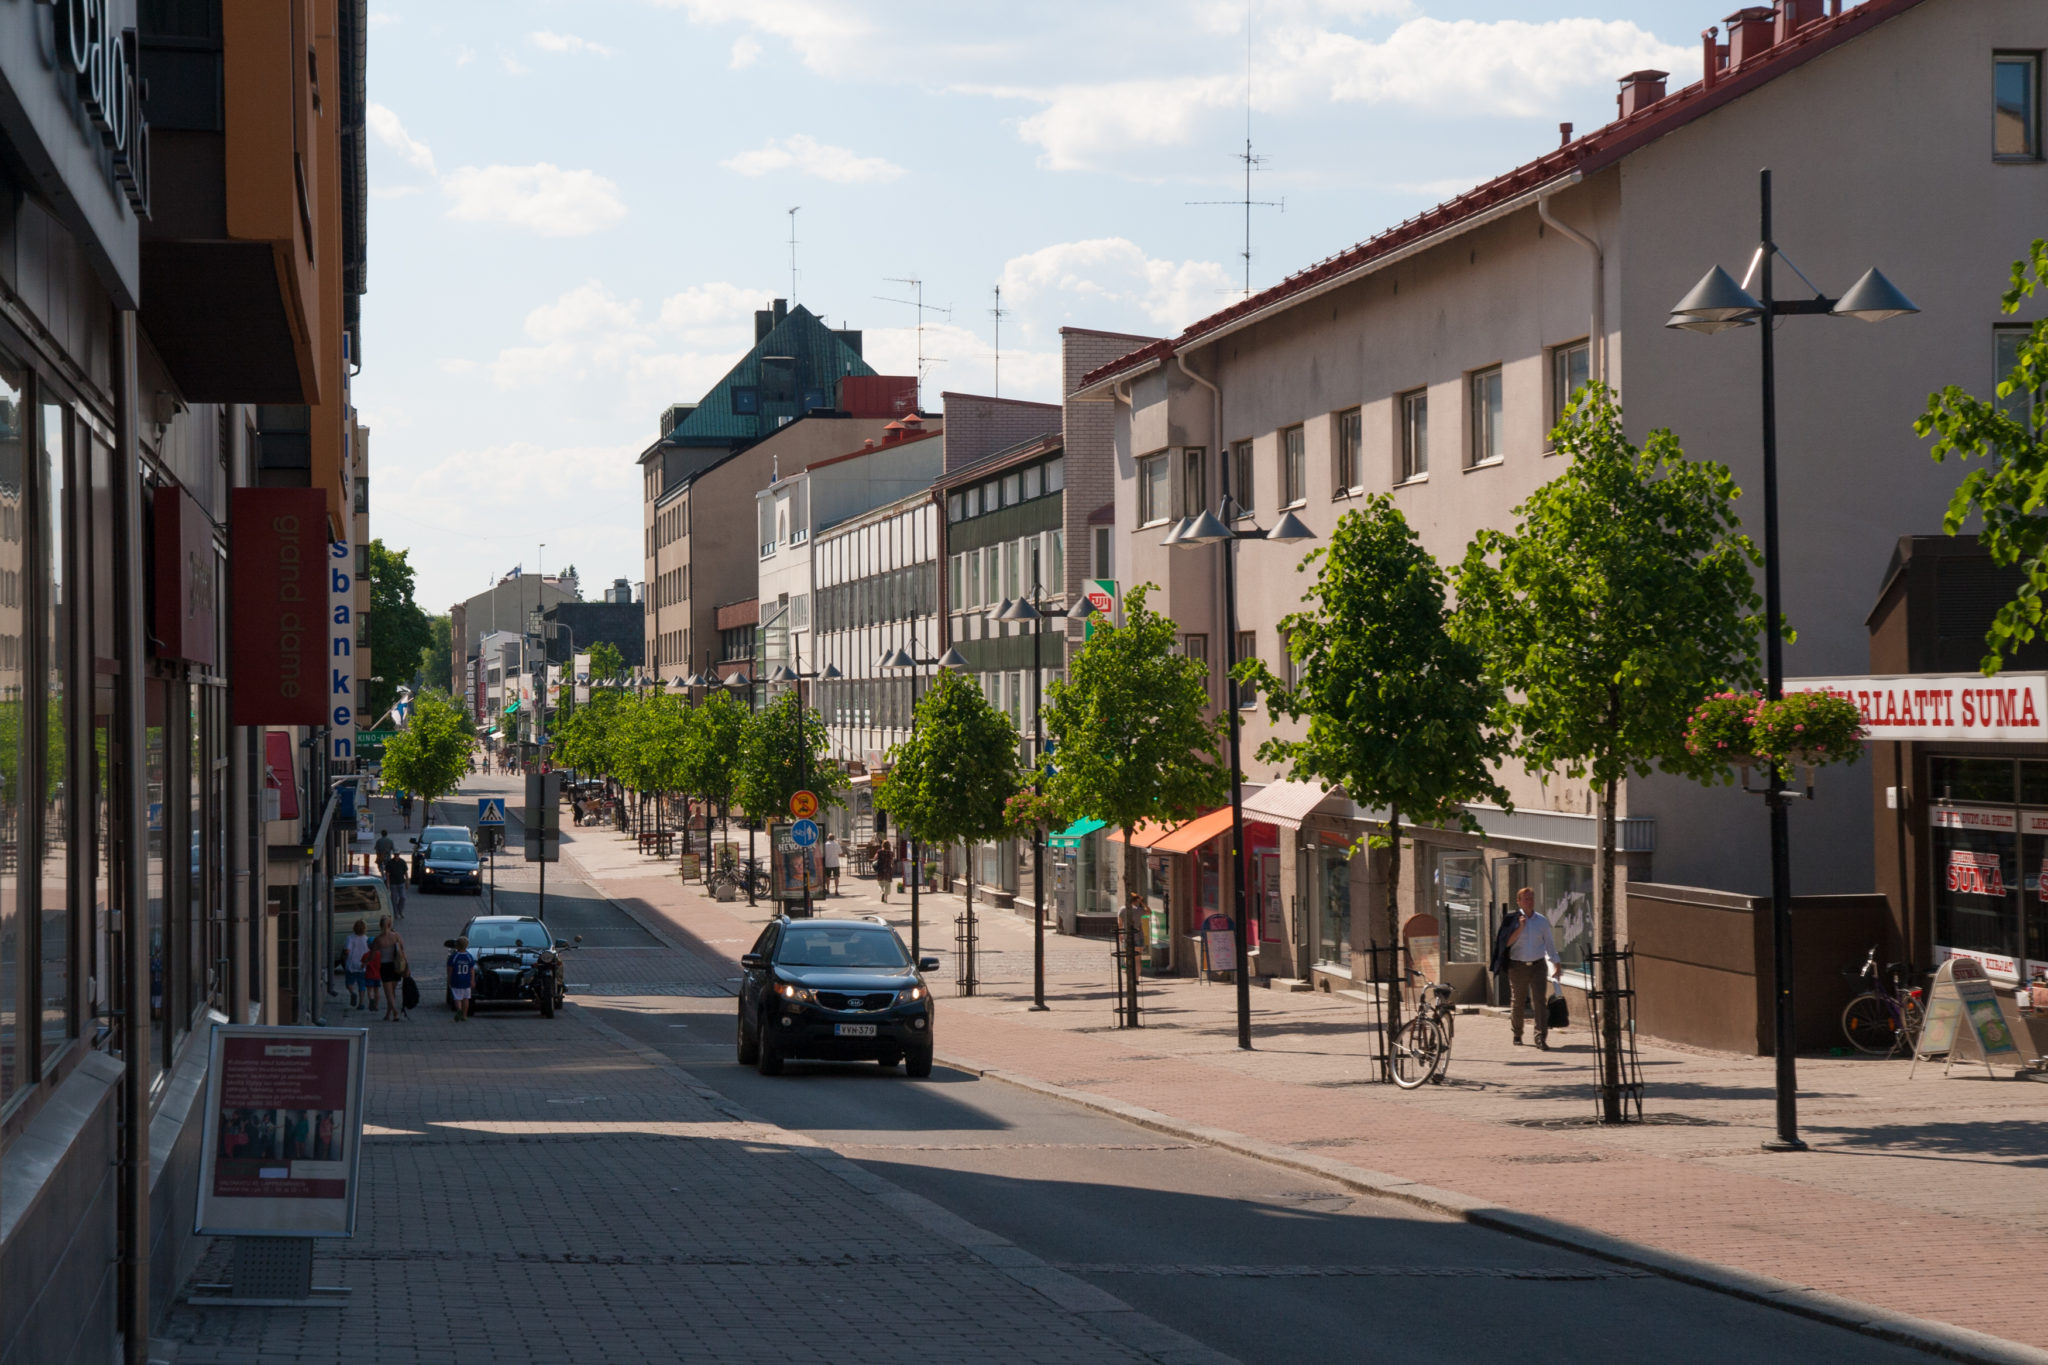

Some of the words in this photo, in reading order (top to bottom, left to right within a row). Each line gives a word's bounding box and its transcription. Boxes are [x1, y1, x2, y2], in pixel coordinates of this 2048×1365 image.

[272, 514, 305, 603] grand
[278, 611, 305, 700] dame
[1961, 686, 2040, 728] SUMA
[1947, 864, 2007, 897] SUMA
[457, 964, 469, 975] 10
